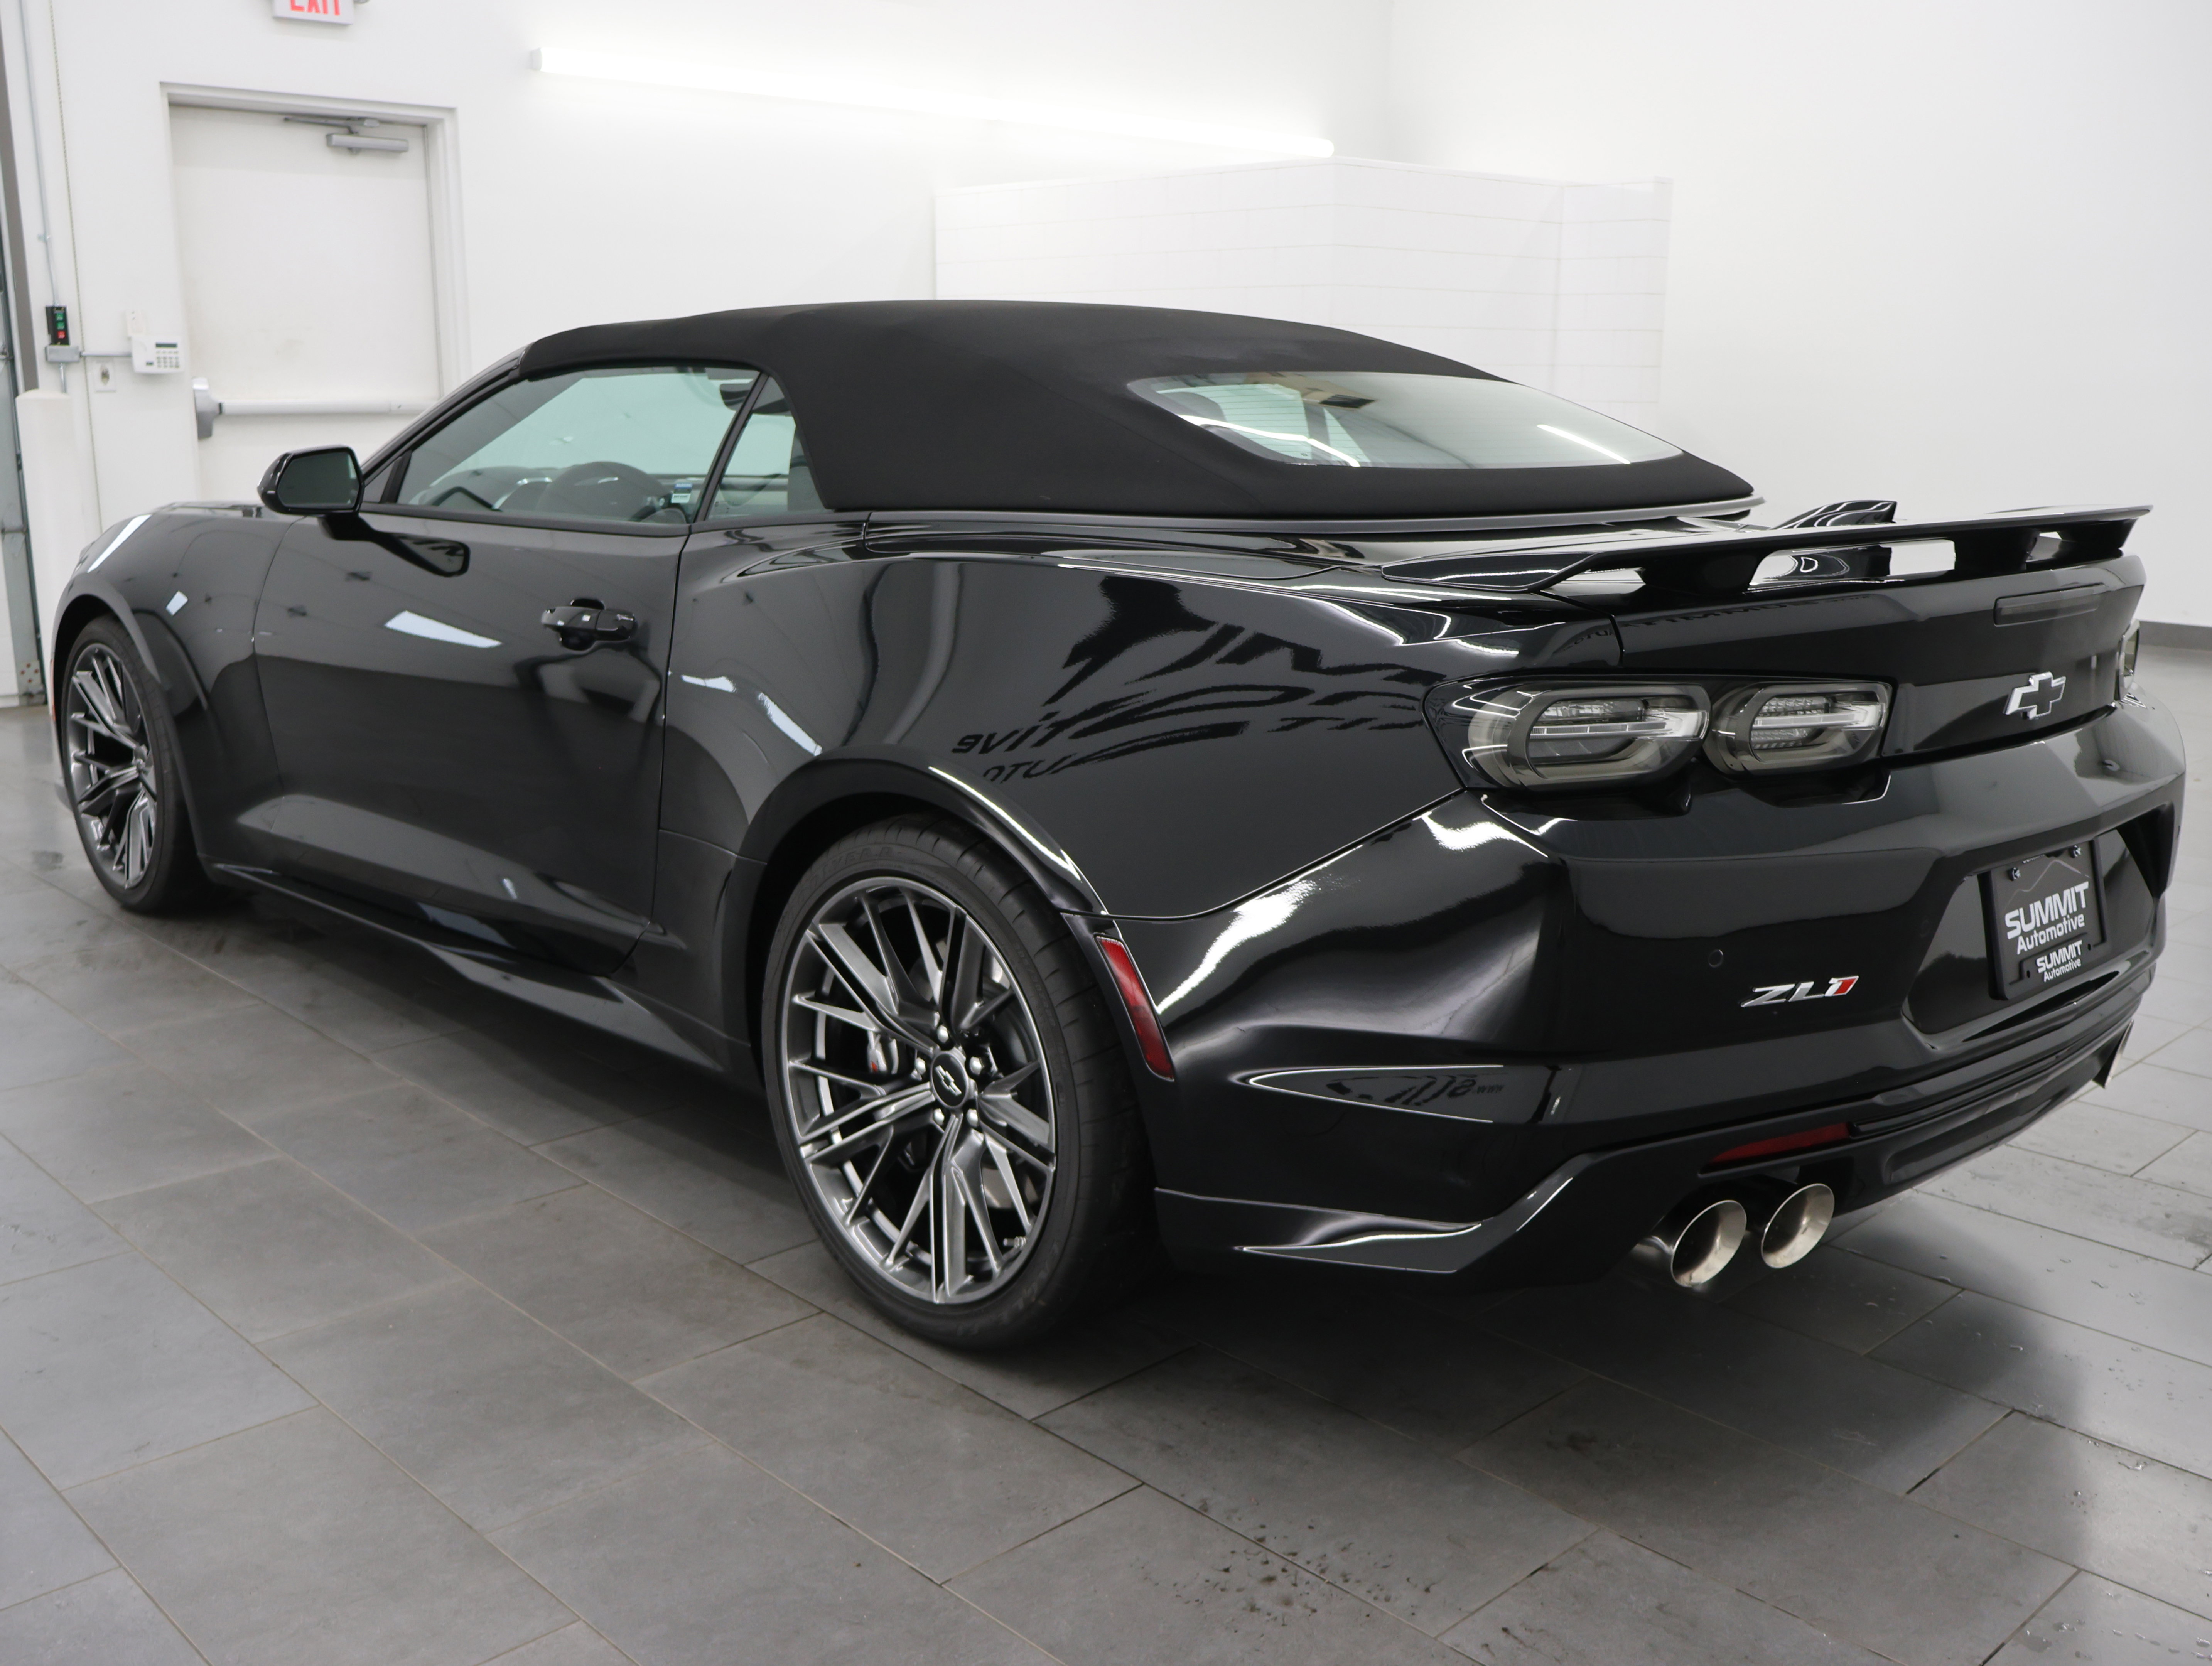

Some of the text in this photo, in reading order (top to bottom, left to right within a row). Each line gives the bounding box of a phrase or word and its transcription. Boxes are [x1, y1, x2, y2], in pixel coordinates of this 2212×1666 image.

[2005, 881, 2089, 939] SUMMIT
[2017, 913, 2085, 954] Automotive
[2036, 940, 2082, 973] SUMMIT
[2043, 958, 2081, 982] Automotive
[1740, 975, 1859, 1007] ZL1
